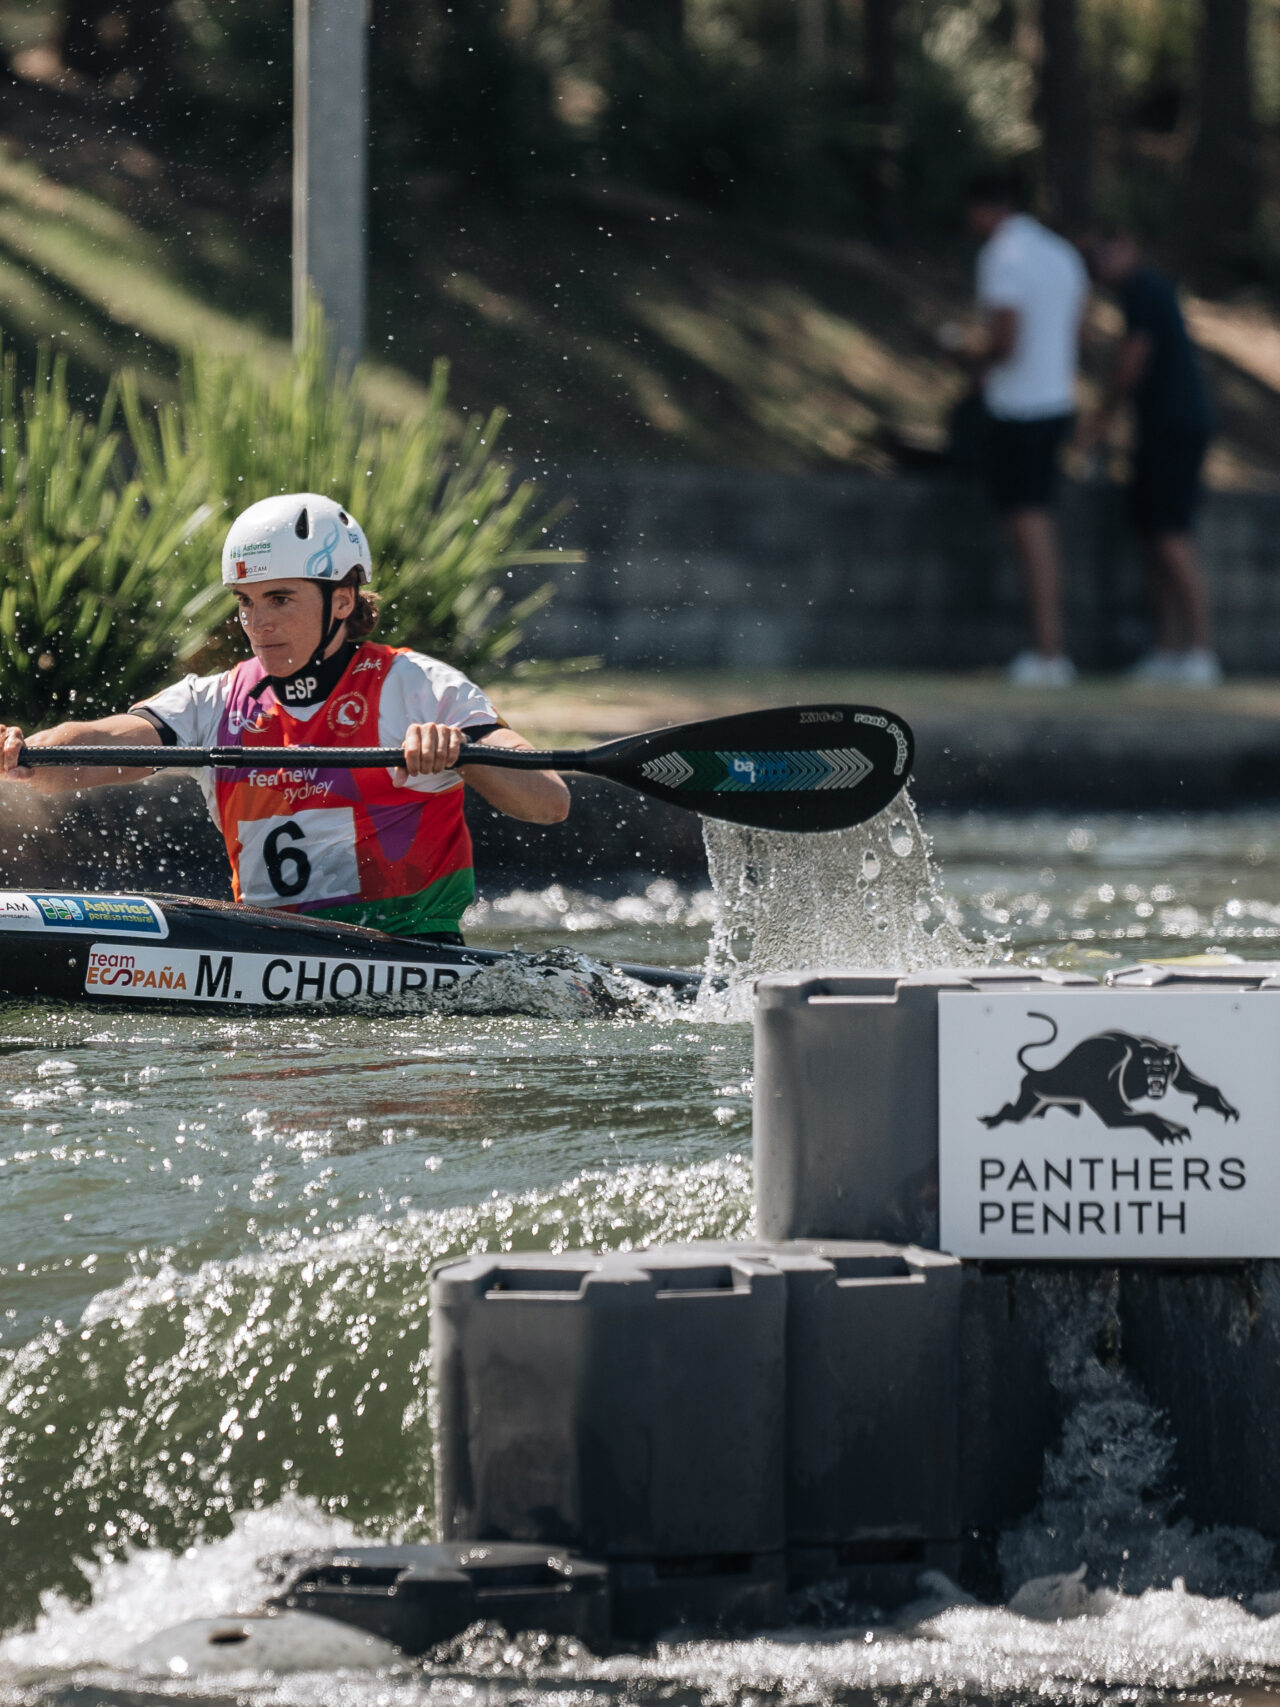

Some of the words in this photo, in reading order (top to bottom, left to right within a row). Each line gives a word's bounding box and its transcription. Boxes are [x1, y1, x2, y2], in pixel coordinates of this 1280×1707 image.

[285, 677, 318, 700] ESP
[281, 767, 318, 784] new
[283, 780, 334, 805] sydney
[263, 820, 311, 897] 6
[83, 900, 150, 914] Asturias
[193, 954, 242, 999] M.
[980, 1157, 1246, 1192] PANTHERS
[979, 1201, 1186, 1234] PENRITH
